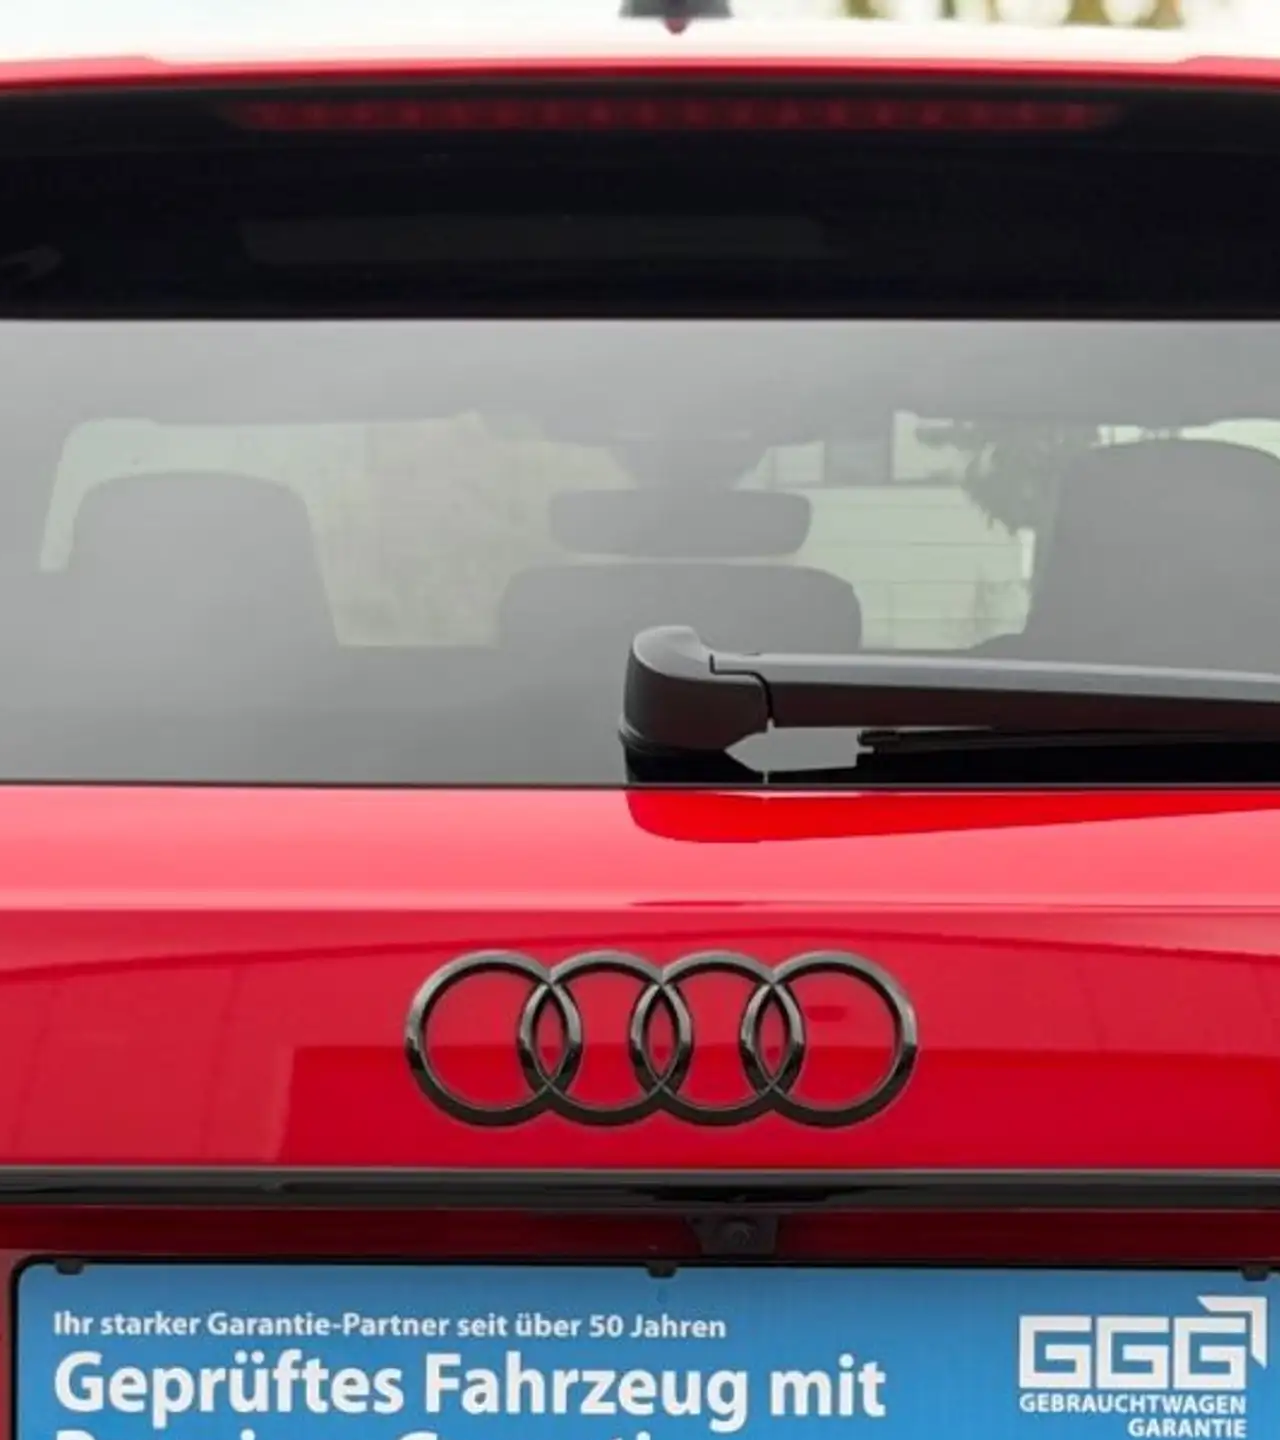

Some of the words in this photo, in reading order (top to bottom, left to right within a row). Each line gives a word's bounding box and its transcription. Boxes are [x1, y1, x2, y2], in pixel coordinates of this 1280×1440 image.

[53, 1311, 94, 1335] Ihr
[100, 1311, 201, 1336] starker
[208, 1312, 450, 1337] Garantie-Partner
[457, 1313, 508, 1337] seit
[516, 1313, 582, 1337] über
[589, 1314, 624, 1338] 50
[630, 1314, 726, 1338] Jahren
[1019, 1315, 1247, 1390] GGG
[54, 1349, 404, 1430] Geprüftes
[425, 1351, 749, 1433] Fahrzeug
[770, 1354, 887, 1417] mit
[1019, 1393, 1246, 1415] GEBRAUCHTWAGEN
[1127, 1417, 1247, 1439] GARANTIE
